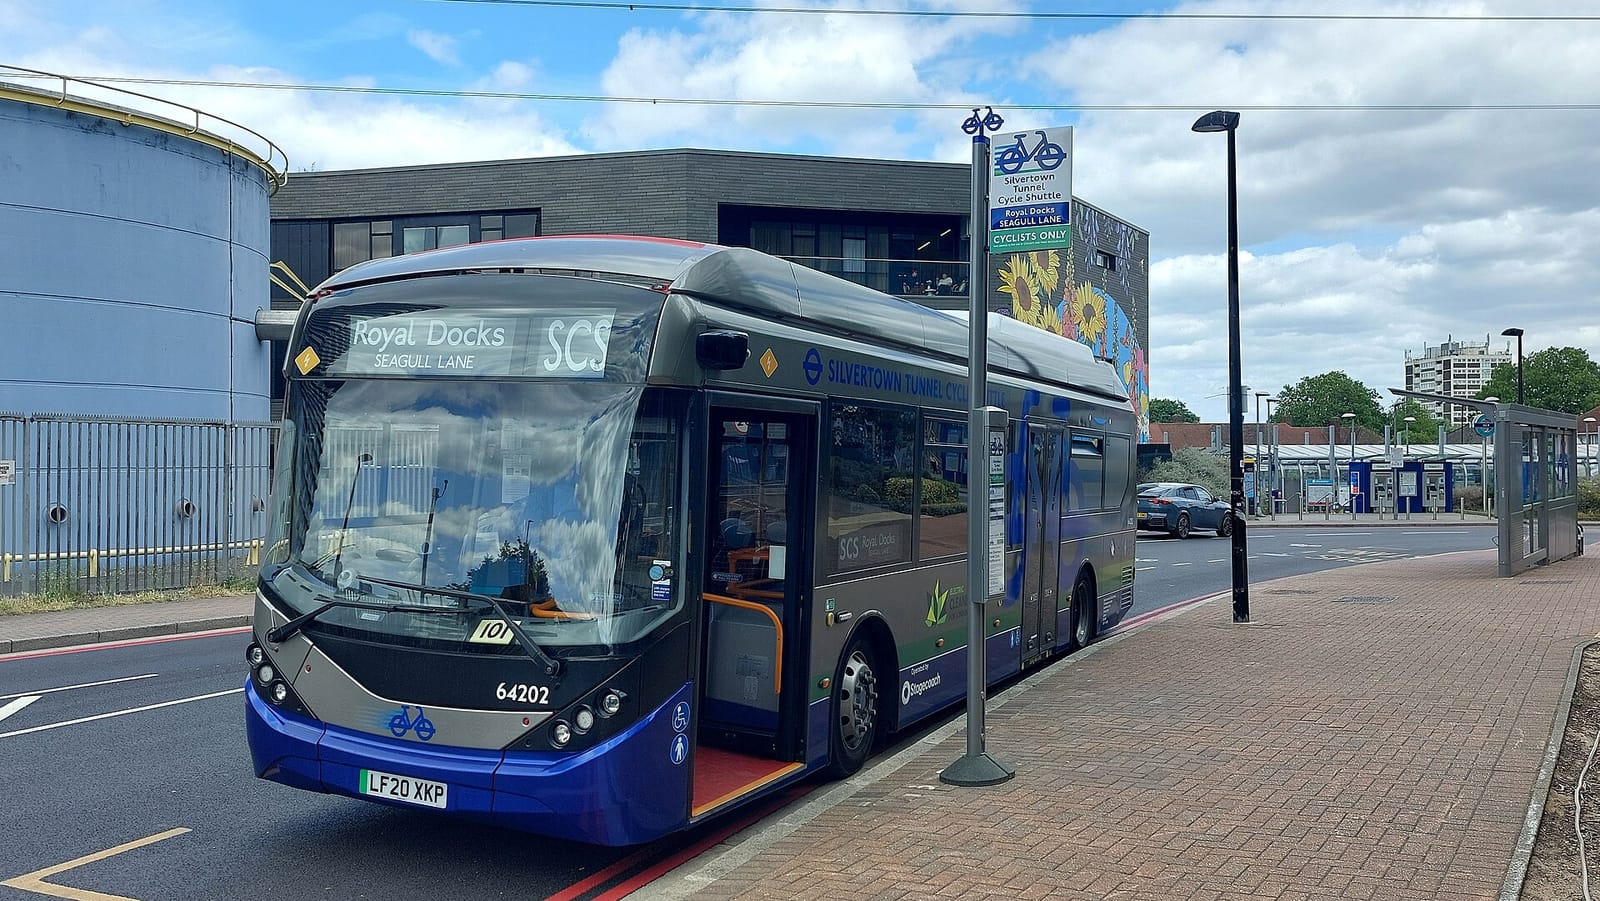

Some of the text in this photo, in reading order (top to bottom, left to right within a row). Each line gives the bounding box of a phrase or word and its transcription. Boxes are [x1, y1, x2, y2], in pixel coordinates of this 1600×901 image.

[1004, 174, 1055, 185] Silvertown
[1013, 183, 1045, 193] Tunnel
[998, 192, 1062, 205] Cycle Shuttle
[1005, 207, 1055, 218] Royal Docks
[999, 215, 1062, 228] SEAGULL LANE
[993, 232, 1037, 244] CYCLISTS
[1039, 230, 1067, 240] ONLY
[353, 319, 505, 352] Royal Docks
[543, 319, 612, 372] SCS
[374, 353, 475, 369] SEAGULL LANE
[828, 358, 901, 393] SILVERTOWN
[905, 374, 943, 399] TUNNEL
[946, 383, 968, 402] CYCL
[840, 536, 859, 560] SCS
[862, 535, 878, 550] Royal
[879, 532, 896, 546] Docks
[479, 622, 509, 639] 101
[911, 664, 924, 676] Operated
[911, 672, 941, 696] Stagecoach
[496, 682, 549, 705] 64202
[370, 773, 444, 803] LF20 XKP
